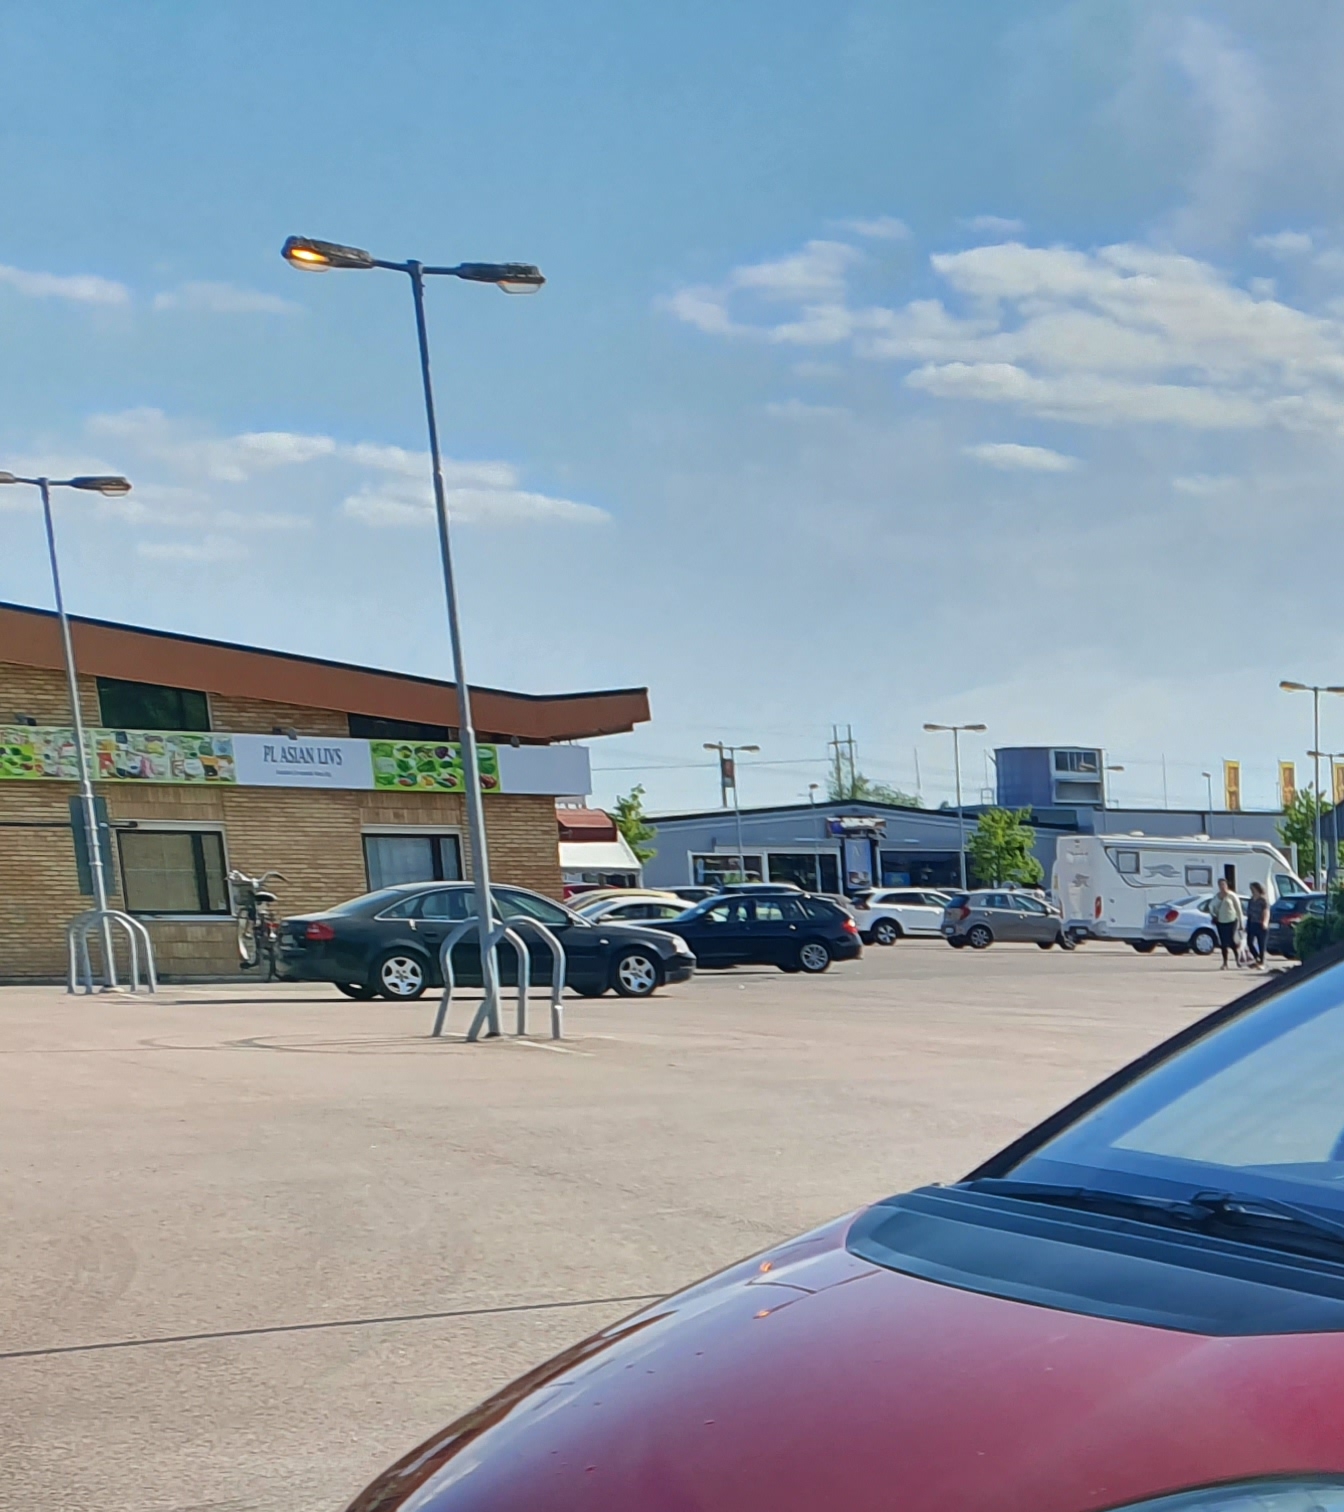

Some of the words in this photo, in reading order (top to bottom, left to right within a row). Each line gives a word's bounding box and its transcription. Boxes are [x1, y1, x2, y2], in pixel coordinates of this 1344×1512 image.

[263, 745, 278, 763] PL
[281, 746, 315, 765] ASIAN
[317, 748, 343, 766] LIVS
